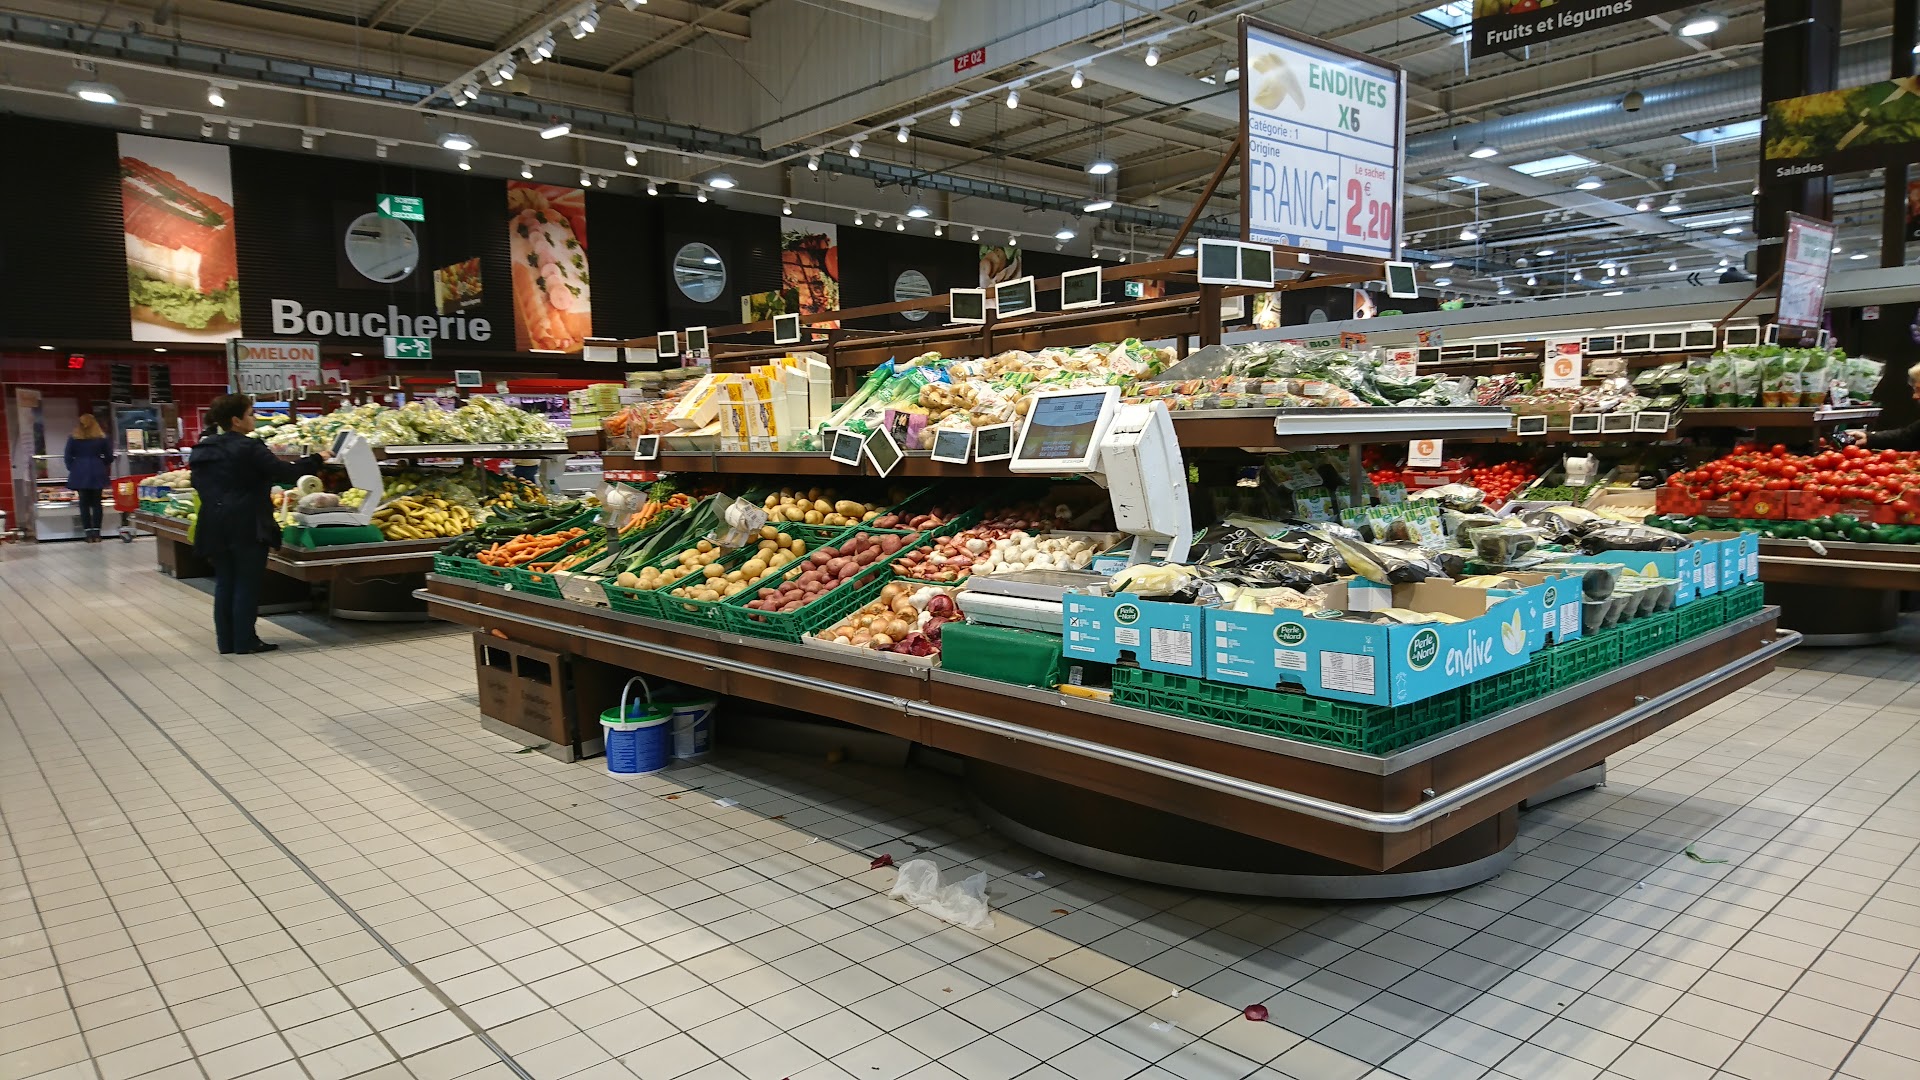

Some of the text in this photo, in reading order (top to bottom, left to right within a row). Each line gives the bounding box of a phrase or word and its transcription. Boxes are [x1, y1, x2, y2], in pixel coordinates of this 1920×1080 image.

[1486, 0, 1633, 46] Fruits et légumes
[957, 50, 982, 69] ZF 02
[1309, 62, 1388, 110] ENDIVES
[1249, 116, 1289, 138] Catégorie
[1250, 138, 1281, 157] Origine
[1354, 163, 1386, 181] Le sachet
[1776, 162, 1825, 178] Salades
[1249, 158, 1338, 232] FRANCE
[1346, 178, 1392, 241] 2,20
[271, 298, 492, 342] Boucherie
[249, 346, 315, 361] MELON
[1309, 340, 1331, 349] BIO
[1281, 625, 1300, 634] Perle
[1284, 632, 1302, 641] Nord
[1413, 636, 1434, 653] Perle
[1416, 645, 1436, 662] Nord
[1444, 628, 1493, 677] endive
